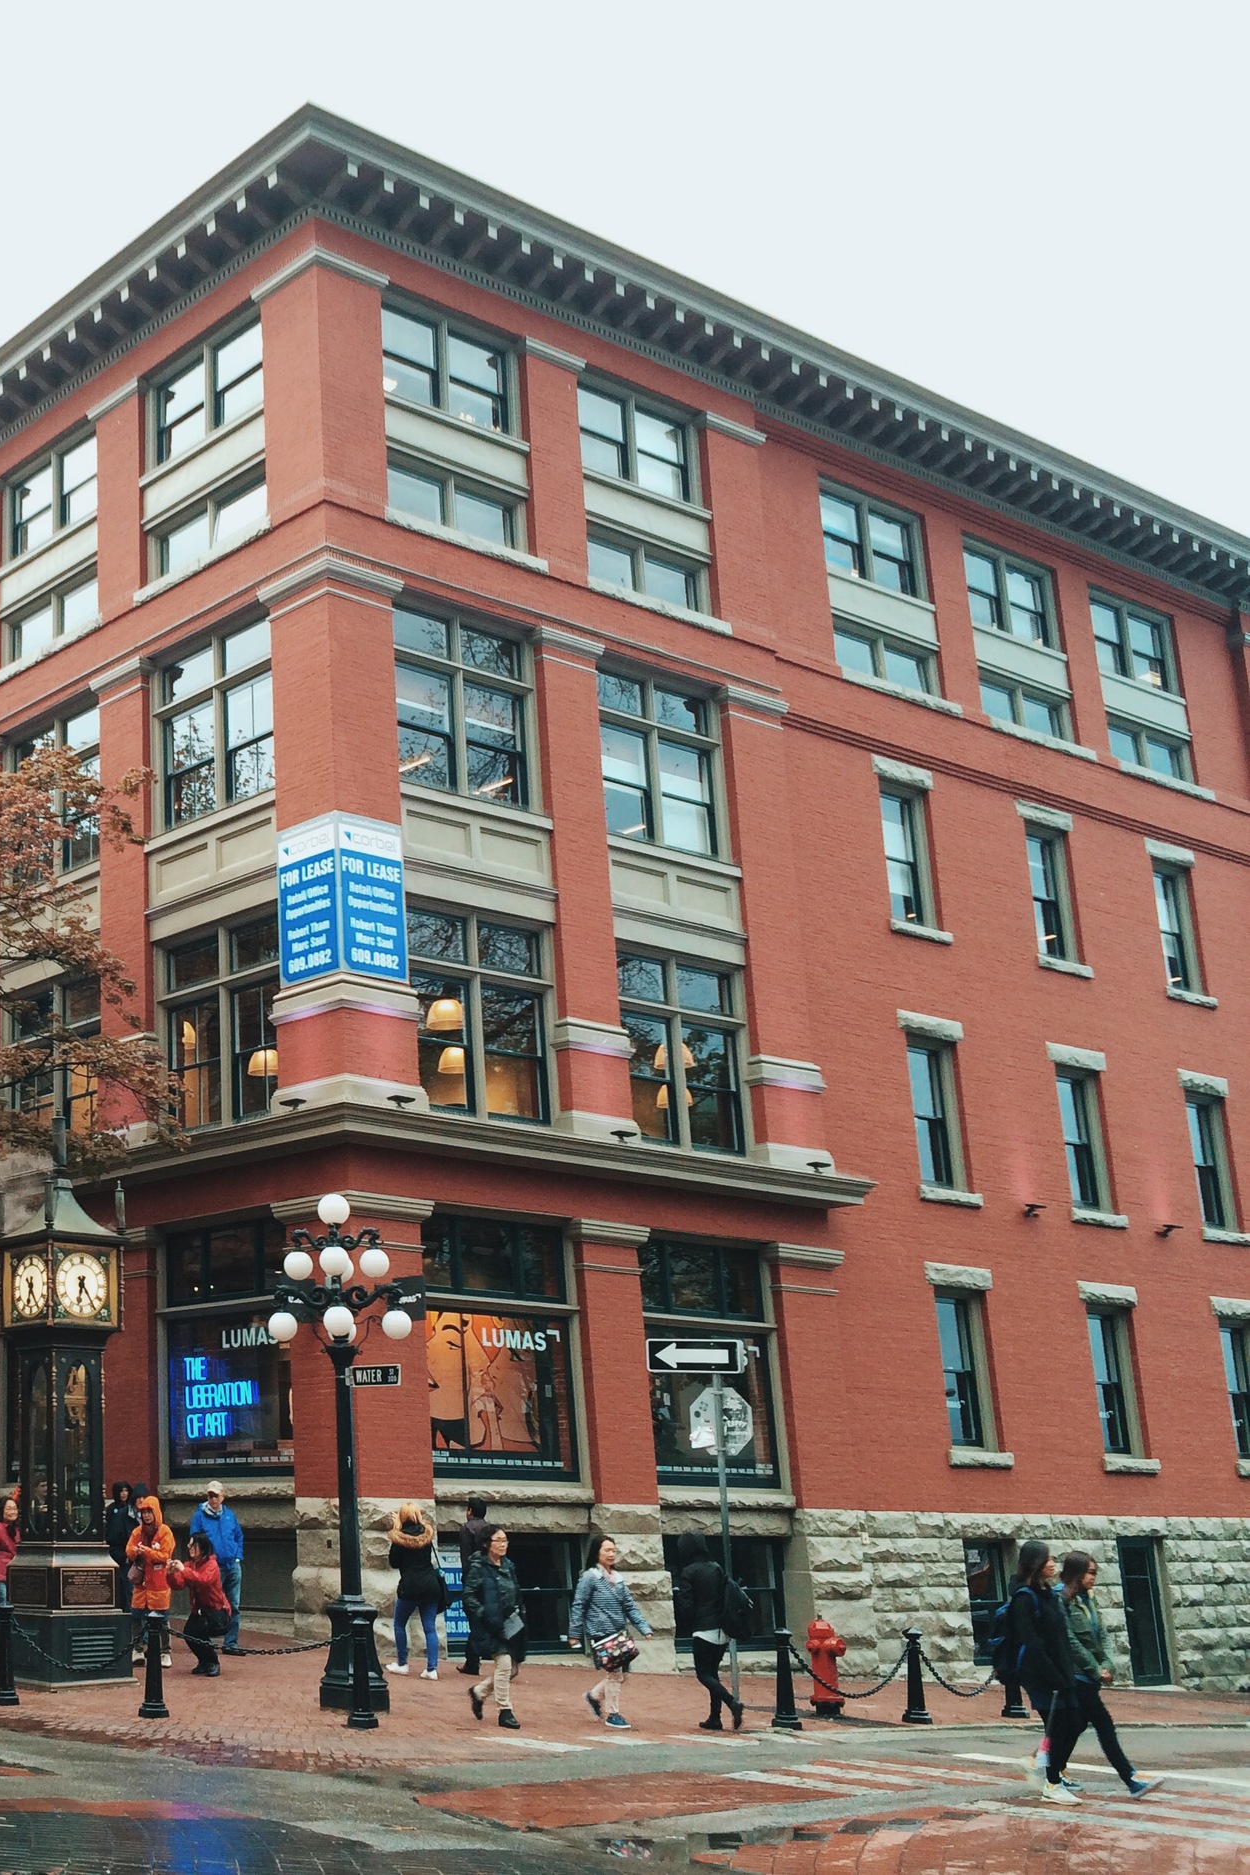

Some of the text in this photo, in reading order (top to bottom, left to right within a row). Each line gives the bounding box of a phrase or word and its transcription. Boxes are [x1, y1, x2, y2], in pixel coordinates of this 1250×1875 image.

[291, 830, 331, 855] corbel
[353, 833, 397, 853] corbel
[281, 857, 334, 889] FOR LEASE
[342, 856, 401, 883] FOR LEASE
[286, 898, 331, 920] Opportunities
[348, 895, 397, 915] Opportunities
[288, 925, 309, 941] Robert
[350, 917, 375, 932] Robert
[288, 949, 332, 974] 609.0882
[351, 947, 399, 970] 609.0882
[481, 1327, 547, 1351] LUMAS
[184, 1357, 206, 1381] THE
[355, 1369, 382, 1383] WATER
[185, 1380, 253, 1409] LIBERATION
[187, 1412, 228, 1439] OF ART
[444, 1572, 455, 1585] OR
